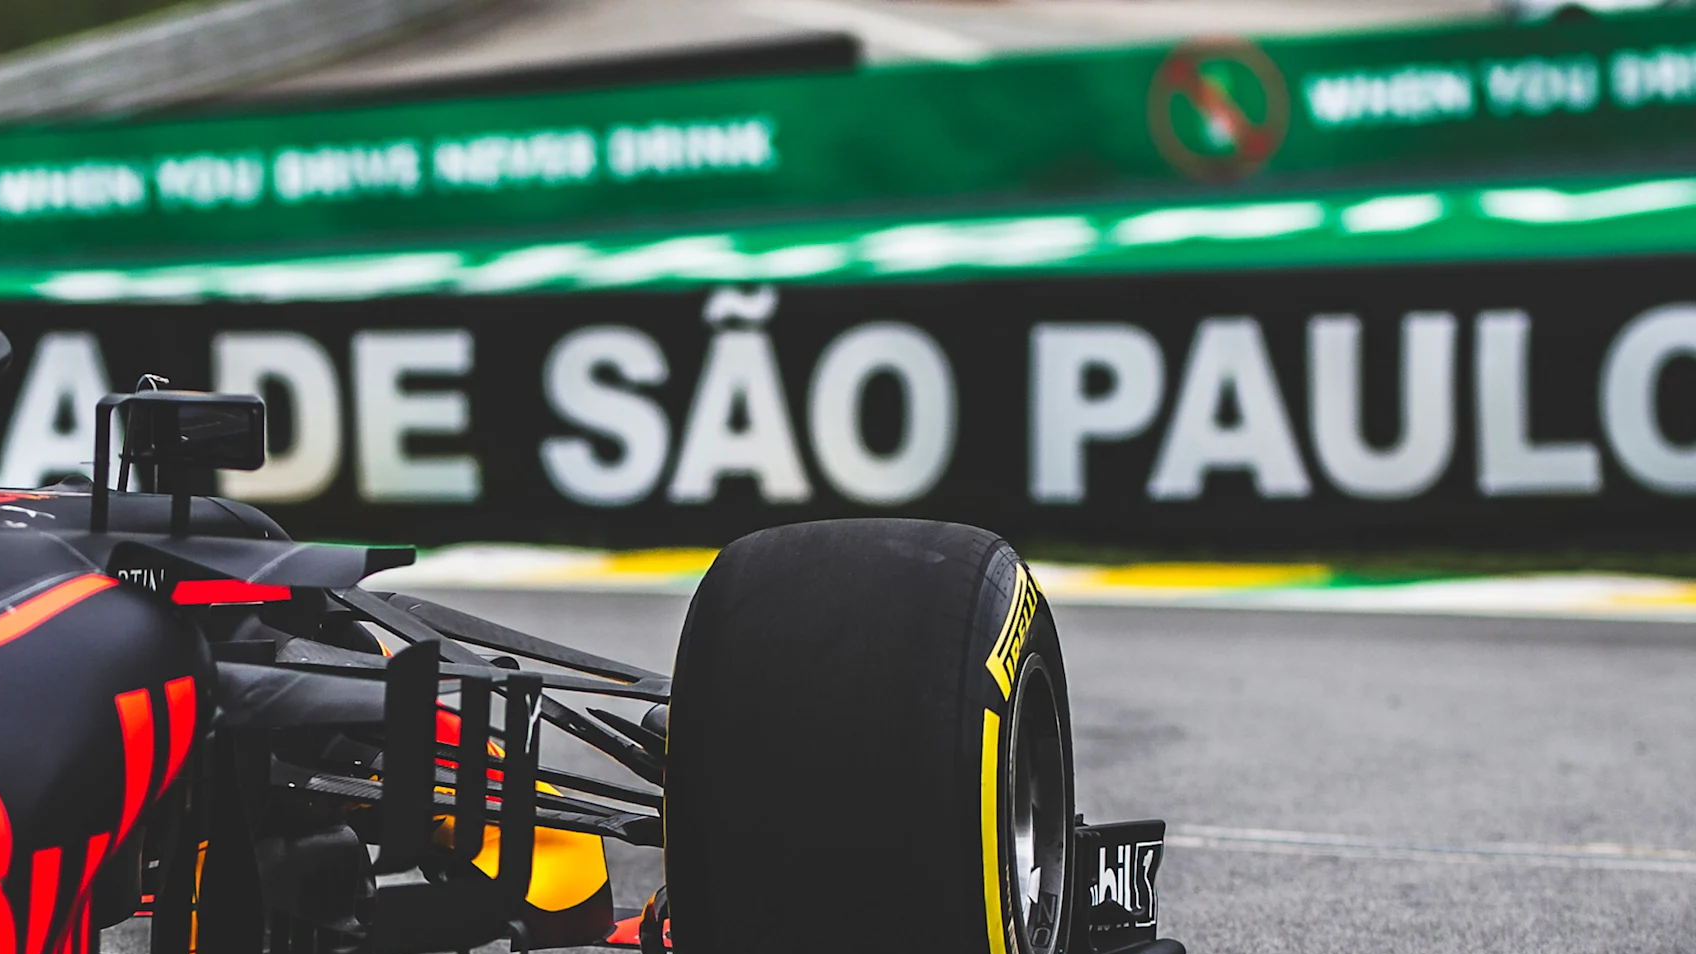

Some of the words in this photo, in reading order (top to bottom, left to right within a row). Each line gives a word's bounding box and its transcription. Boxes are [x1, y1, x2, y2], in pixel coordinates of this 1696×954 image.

[154, 150, 265, 210] YOU
[272, 140, 420, 203] DRIVE
[432, 124, 598, 192] NEVER
[606, 112, 776, 182] DRINK
[212, 326, 484, 504] DE
[538, 286, 960, 508] SÃO
[1026, 300, 1696, 504] PAULO
